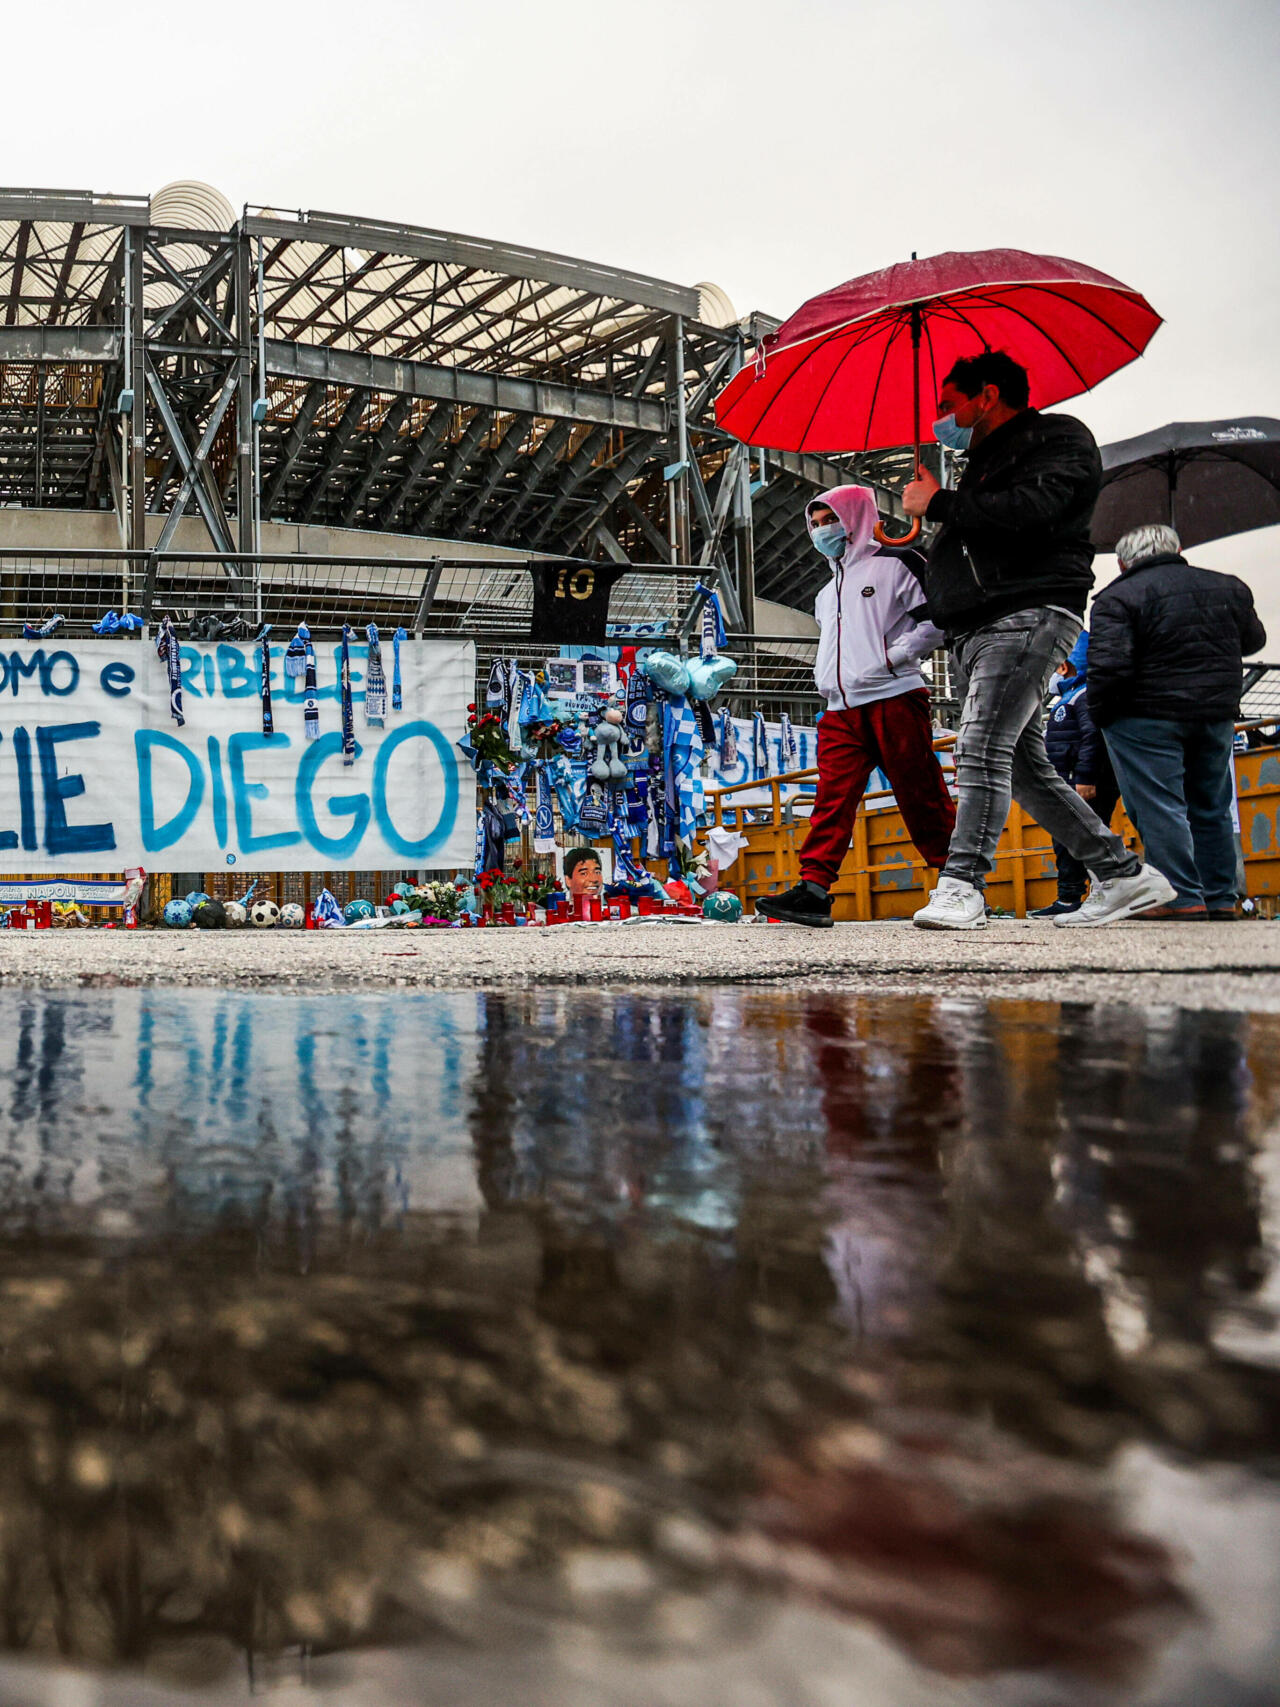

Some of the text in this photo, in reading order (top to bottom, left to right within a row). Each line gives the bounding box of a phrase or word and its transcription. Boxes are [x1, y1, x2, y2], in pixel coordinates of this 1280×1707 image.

[555, 569, 595, 600] 10
[100, 662, 135, 697] e
[134, 720, 460, 860] DIEGO
[27, 887, 77, 899] NAPOLI
